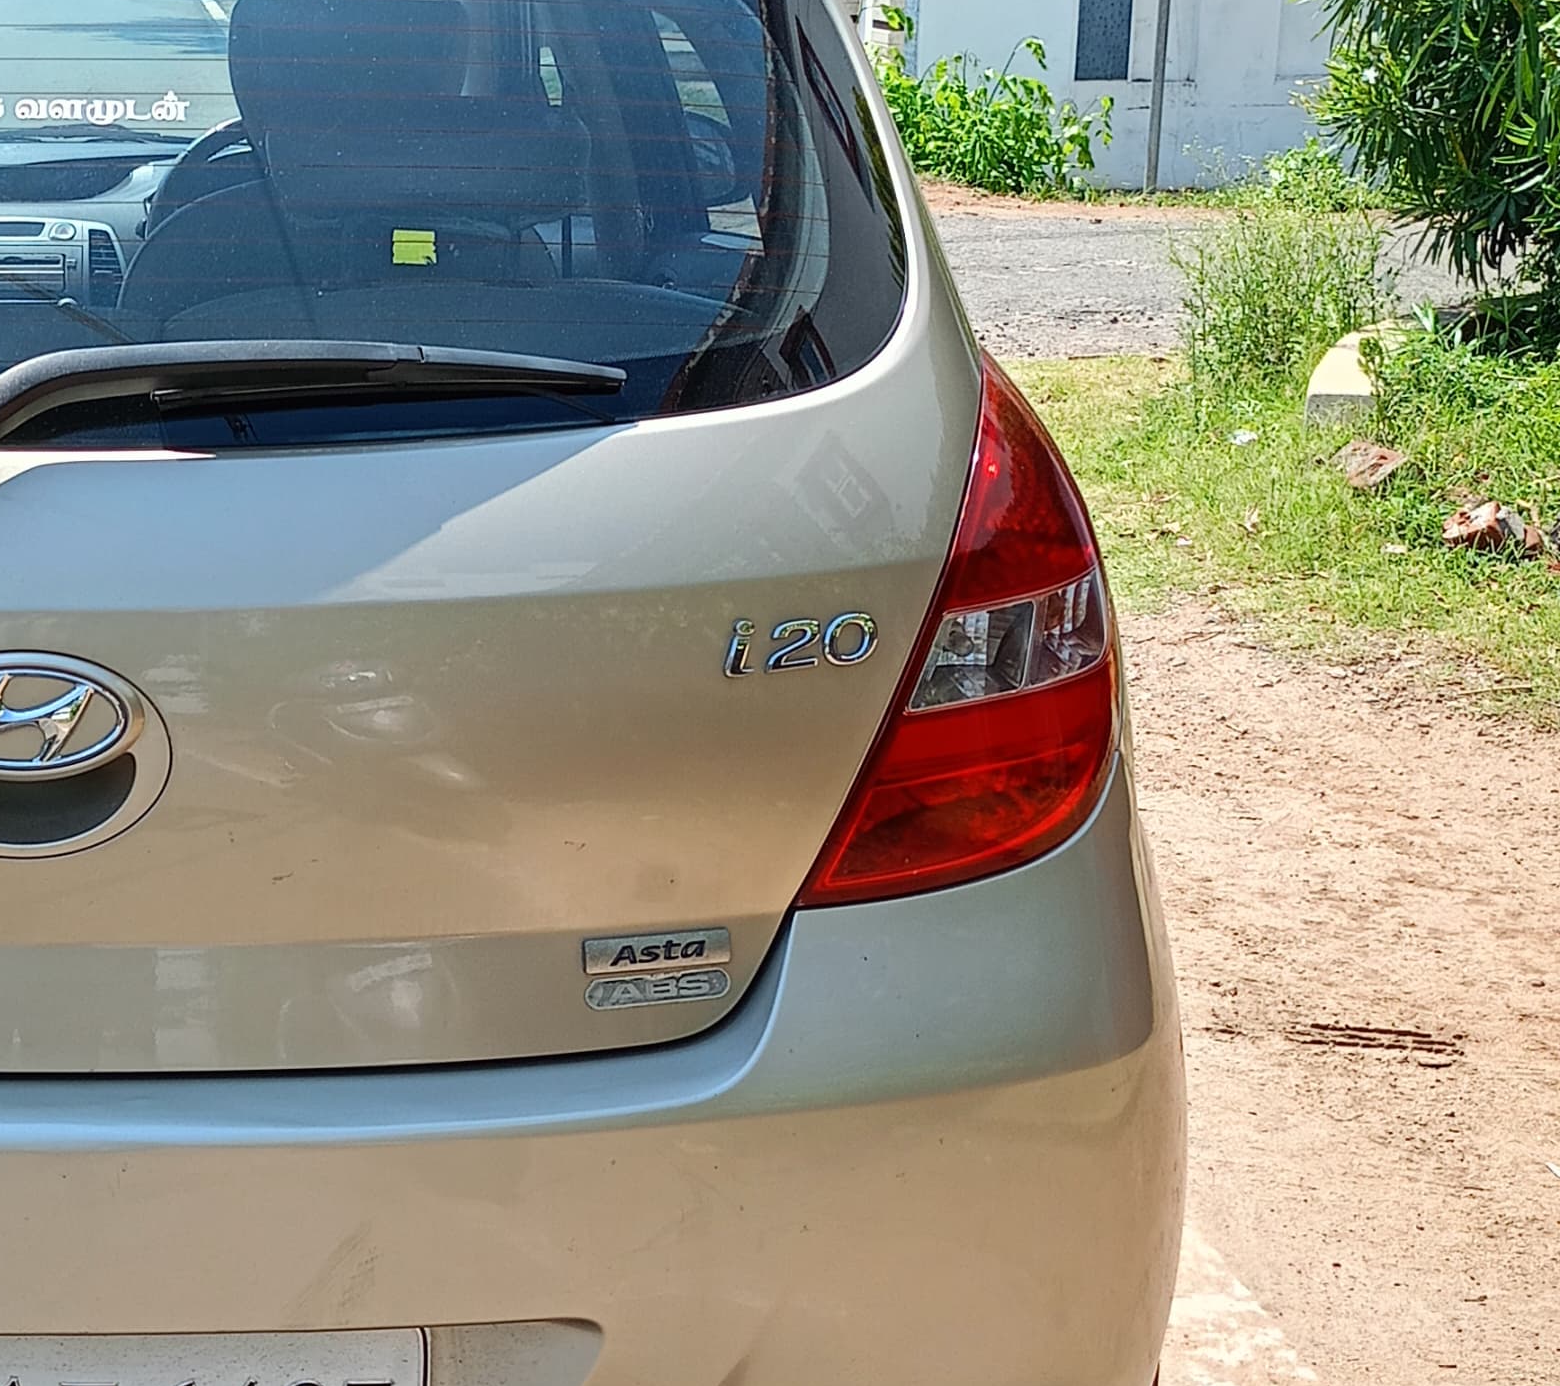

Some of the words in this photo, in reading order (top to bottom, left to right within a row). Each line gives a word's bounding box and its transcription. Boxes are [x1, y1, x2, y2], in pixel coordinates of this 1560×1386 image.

[14, 90, 191, 125] வளமுடன்
[723, 610, 880, 679] i20
[609, 939, 708, 967] Asta
[607, 974, 712, 1004] ABS
